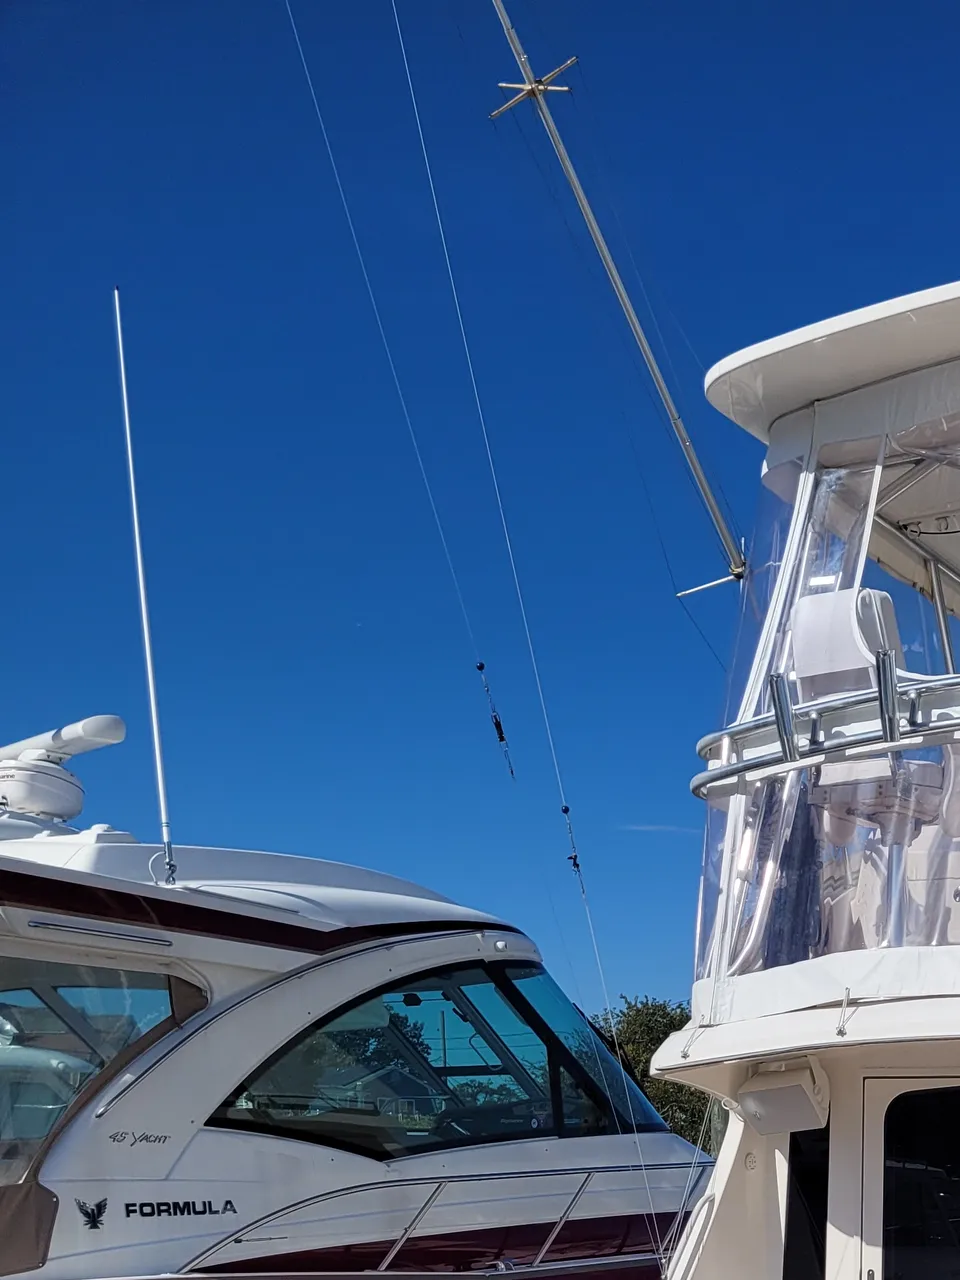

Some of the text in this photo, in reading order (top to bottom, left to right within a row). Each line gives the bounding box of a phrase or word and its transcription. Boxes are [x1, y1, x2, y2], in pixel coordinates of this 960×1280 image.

[109, 1131, 171, 1147] 45 YACHT
[125, 1200, 238, 1218] FORMULA
